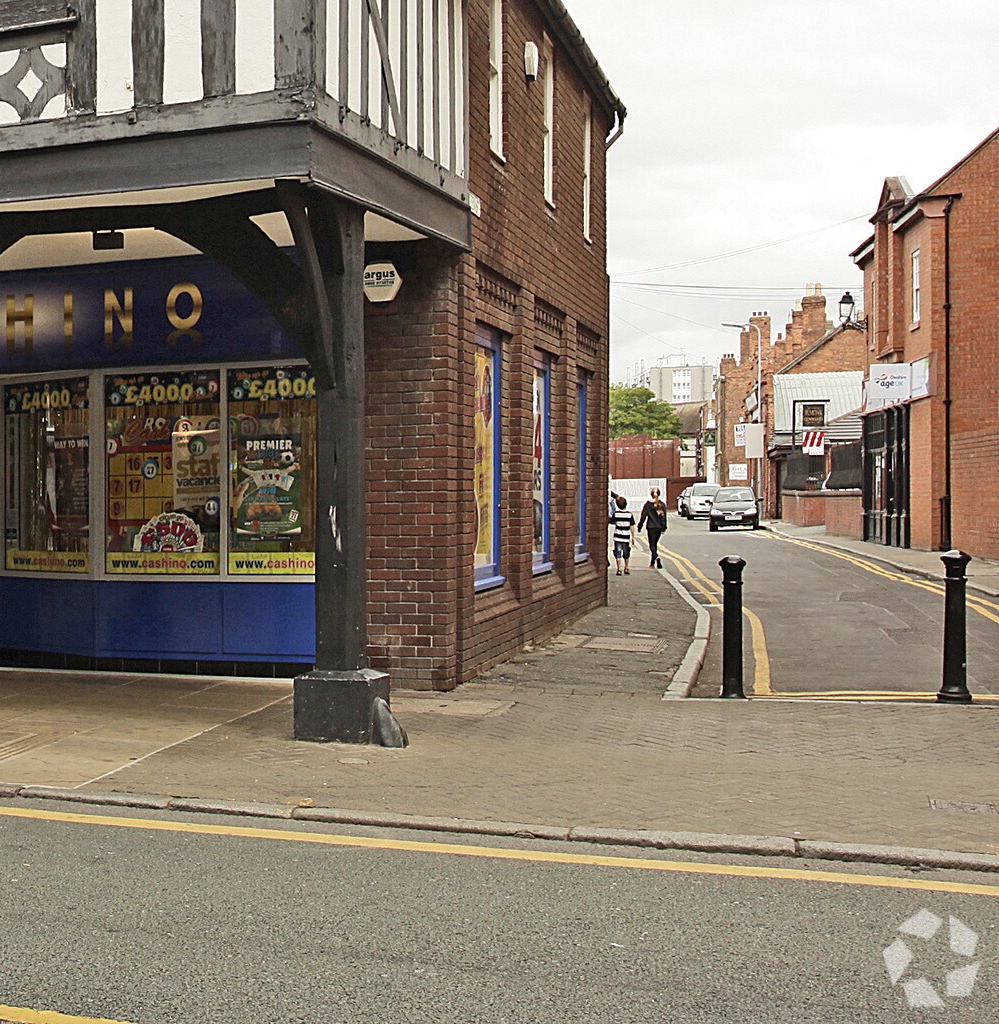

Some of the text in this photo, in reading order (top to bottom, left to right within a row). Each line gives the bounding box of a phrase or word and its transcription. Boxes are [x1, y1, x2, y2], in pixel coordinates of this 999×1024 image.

[364, 271, 395, 280] argus
[880, 380, 895, 389] age
[124, 384, 194, 404] £4000
[68, 439, 76, 448] TO
[246, 440, 293, 451] PREMIER
[13, 557, 85, 568] www.cashino.com
[112, 558, 215, 569] www.cashino.com
[235, 558, 315, 569] www.cashino
